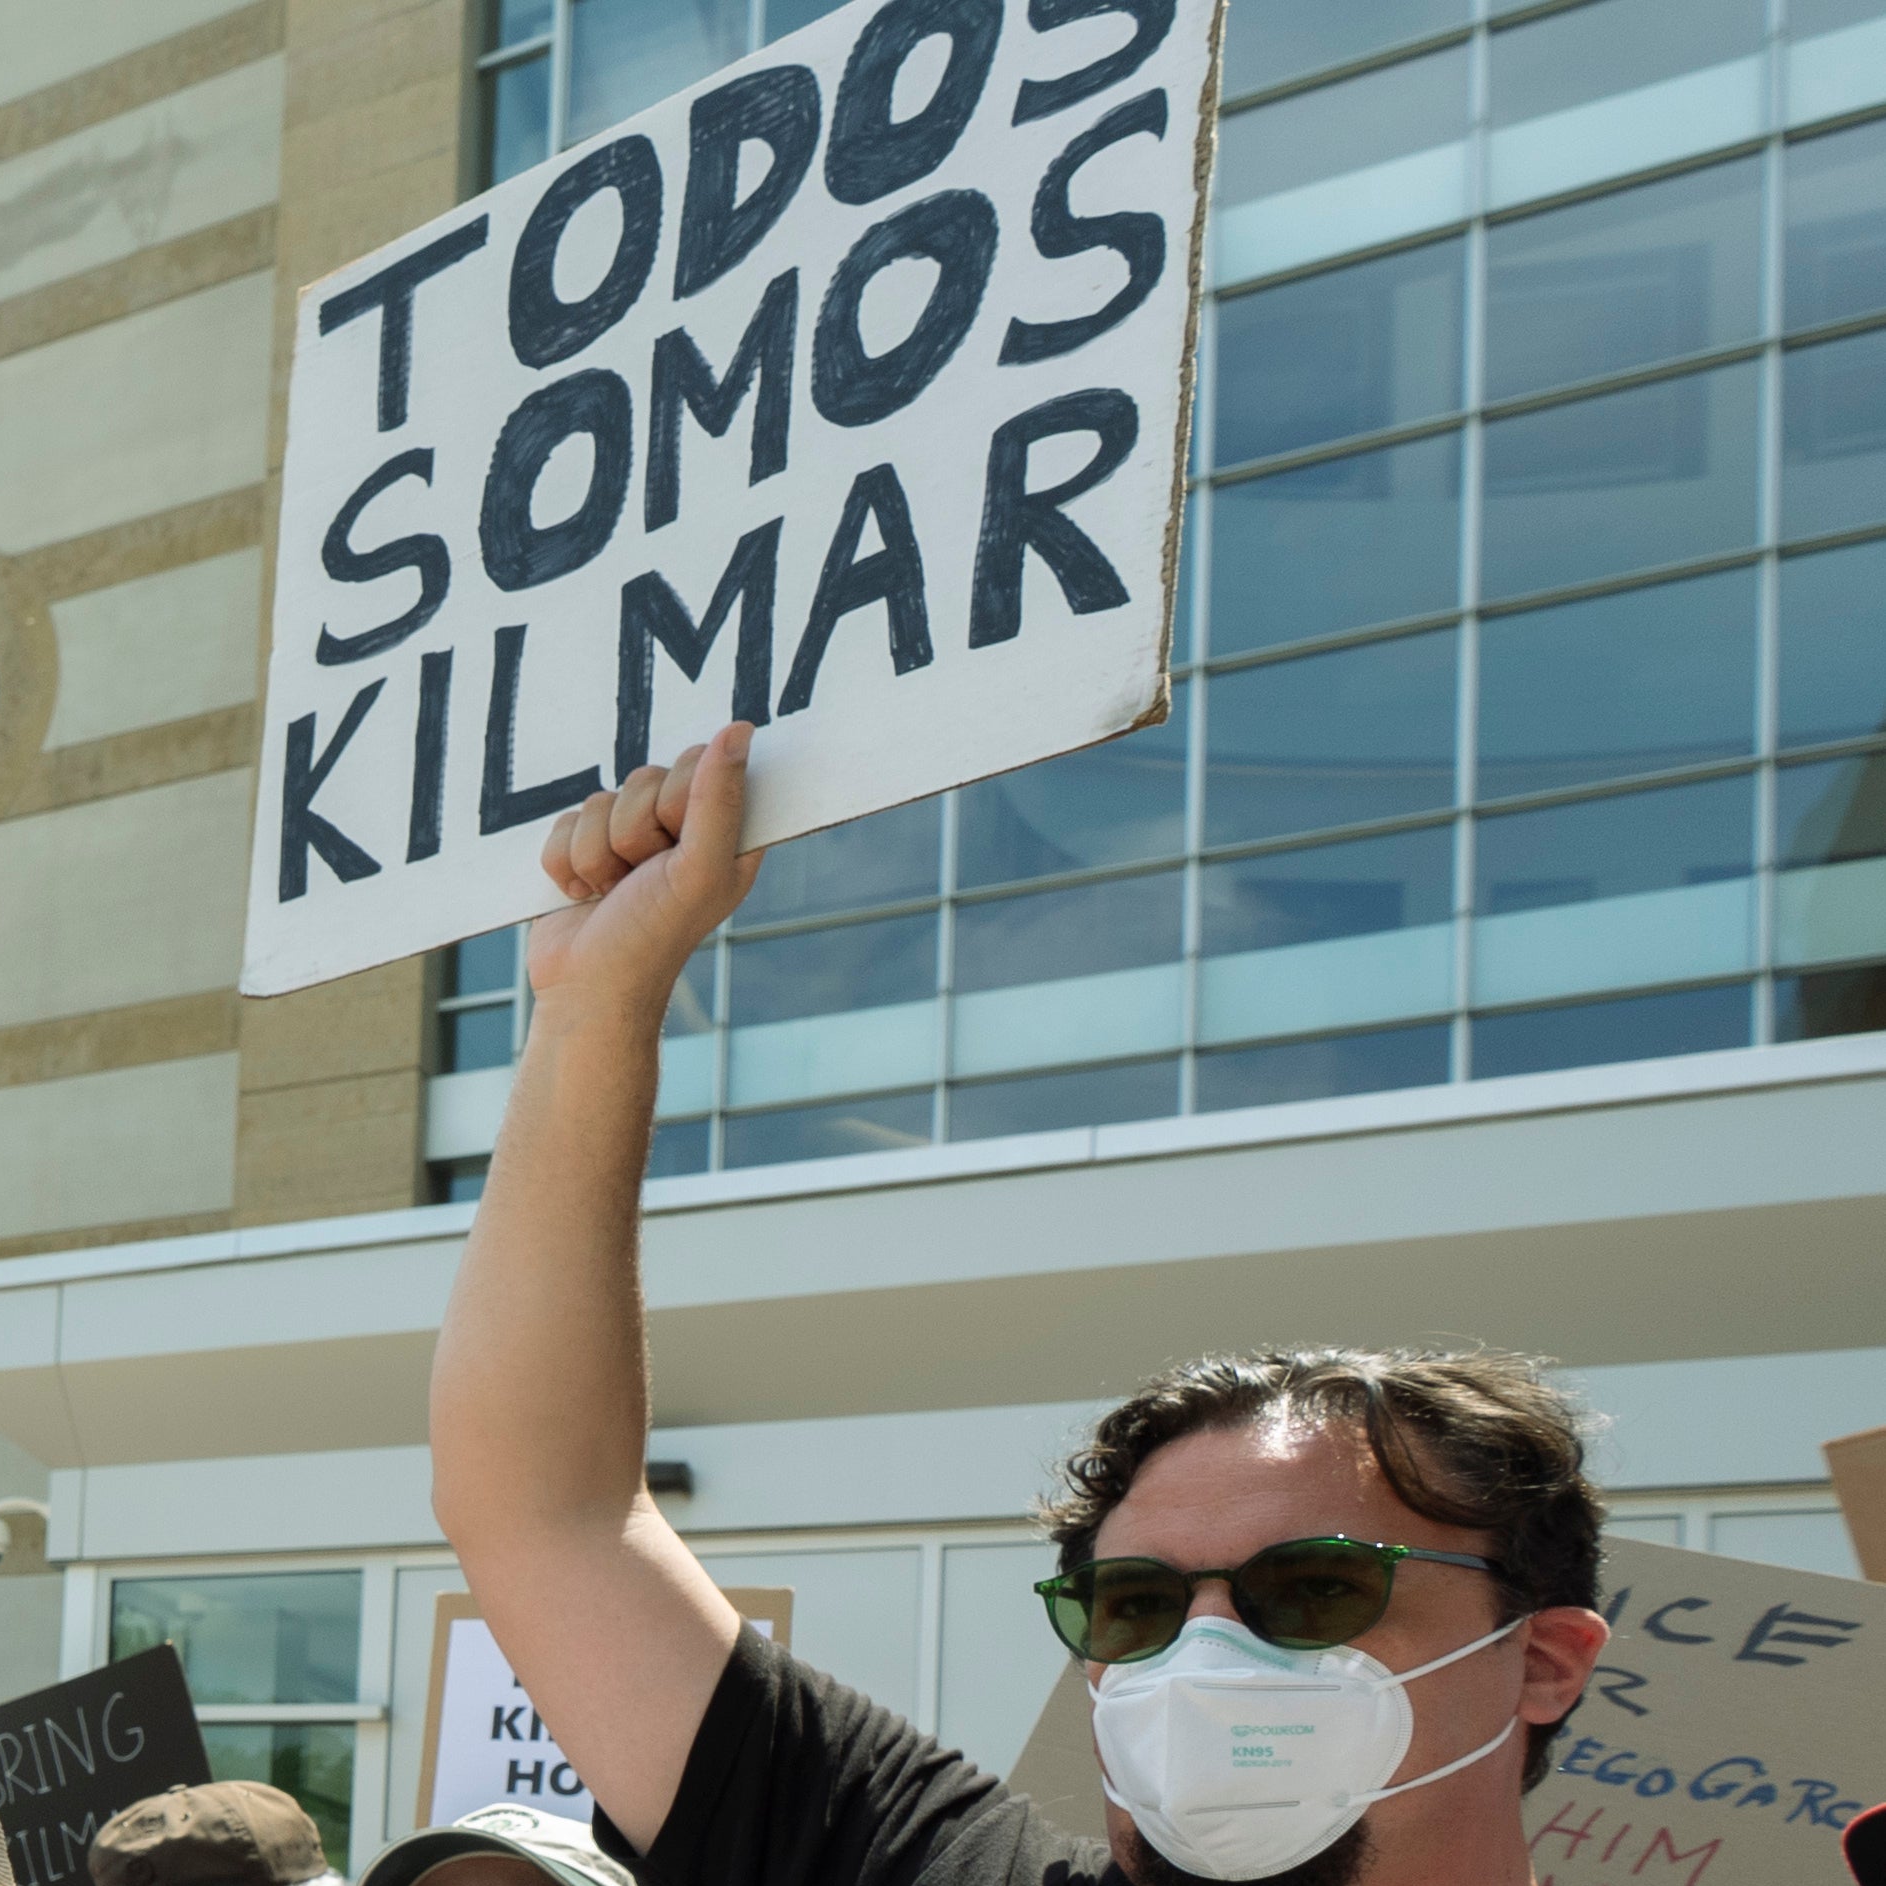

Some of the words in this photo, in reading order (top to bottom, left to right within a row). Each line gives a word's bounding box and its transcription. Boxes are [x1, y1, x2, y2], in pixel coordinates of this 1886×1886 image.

[319, 0, 1176, 432] TODOS
[315, 87, 1168, 668] SOMOS
[278, 386, 1139, 903] KILMAR
[491, 1705, 558, 1742] KI
[506, 1760, 586, 1798] HO
[1232, 1746, 1274, 1757] KN95
